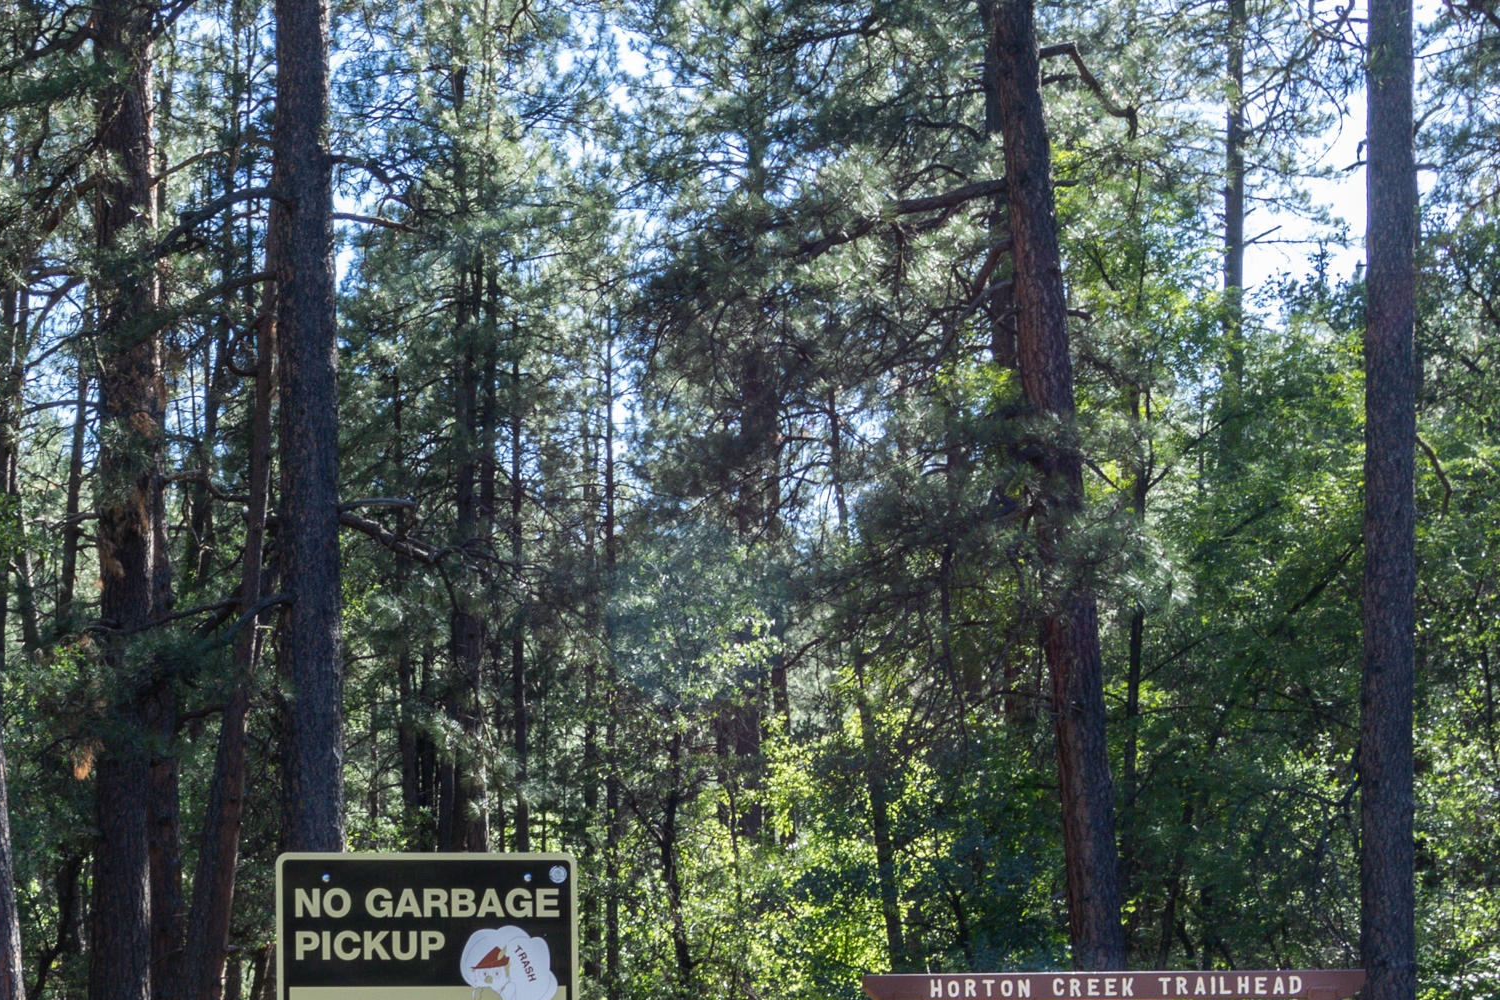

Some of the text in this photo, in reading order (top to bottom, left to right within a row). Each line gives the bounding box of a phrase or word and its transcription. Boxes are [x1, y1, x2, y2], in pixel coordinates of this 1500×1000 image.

[294, 887, 560, 918] NO GARBAGE
[295, 930, 445, 961] PICKUP
[514, 945, 537, 982] TRASH
[929, 975, 1302, 998] HORTON CREEK TRAILHEAD
